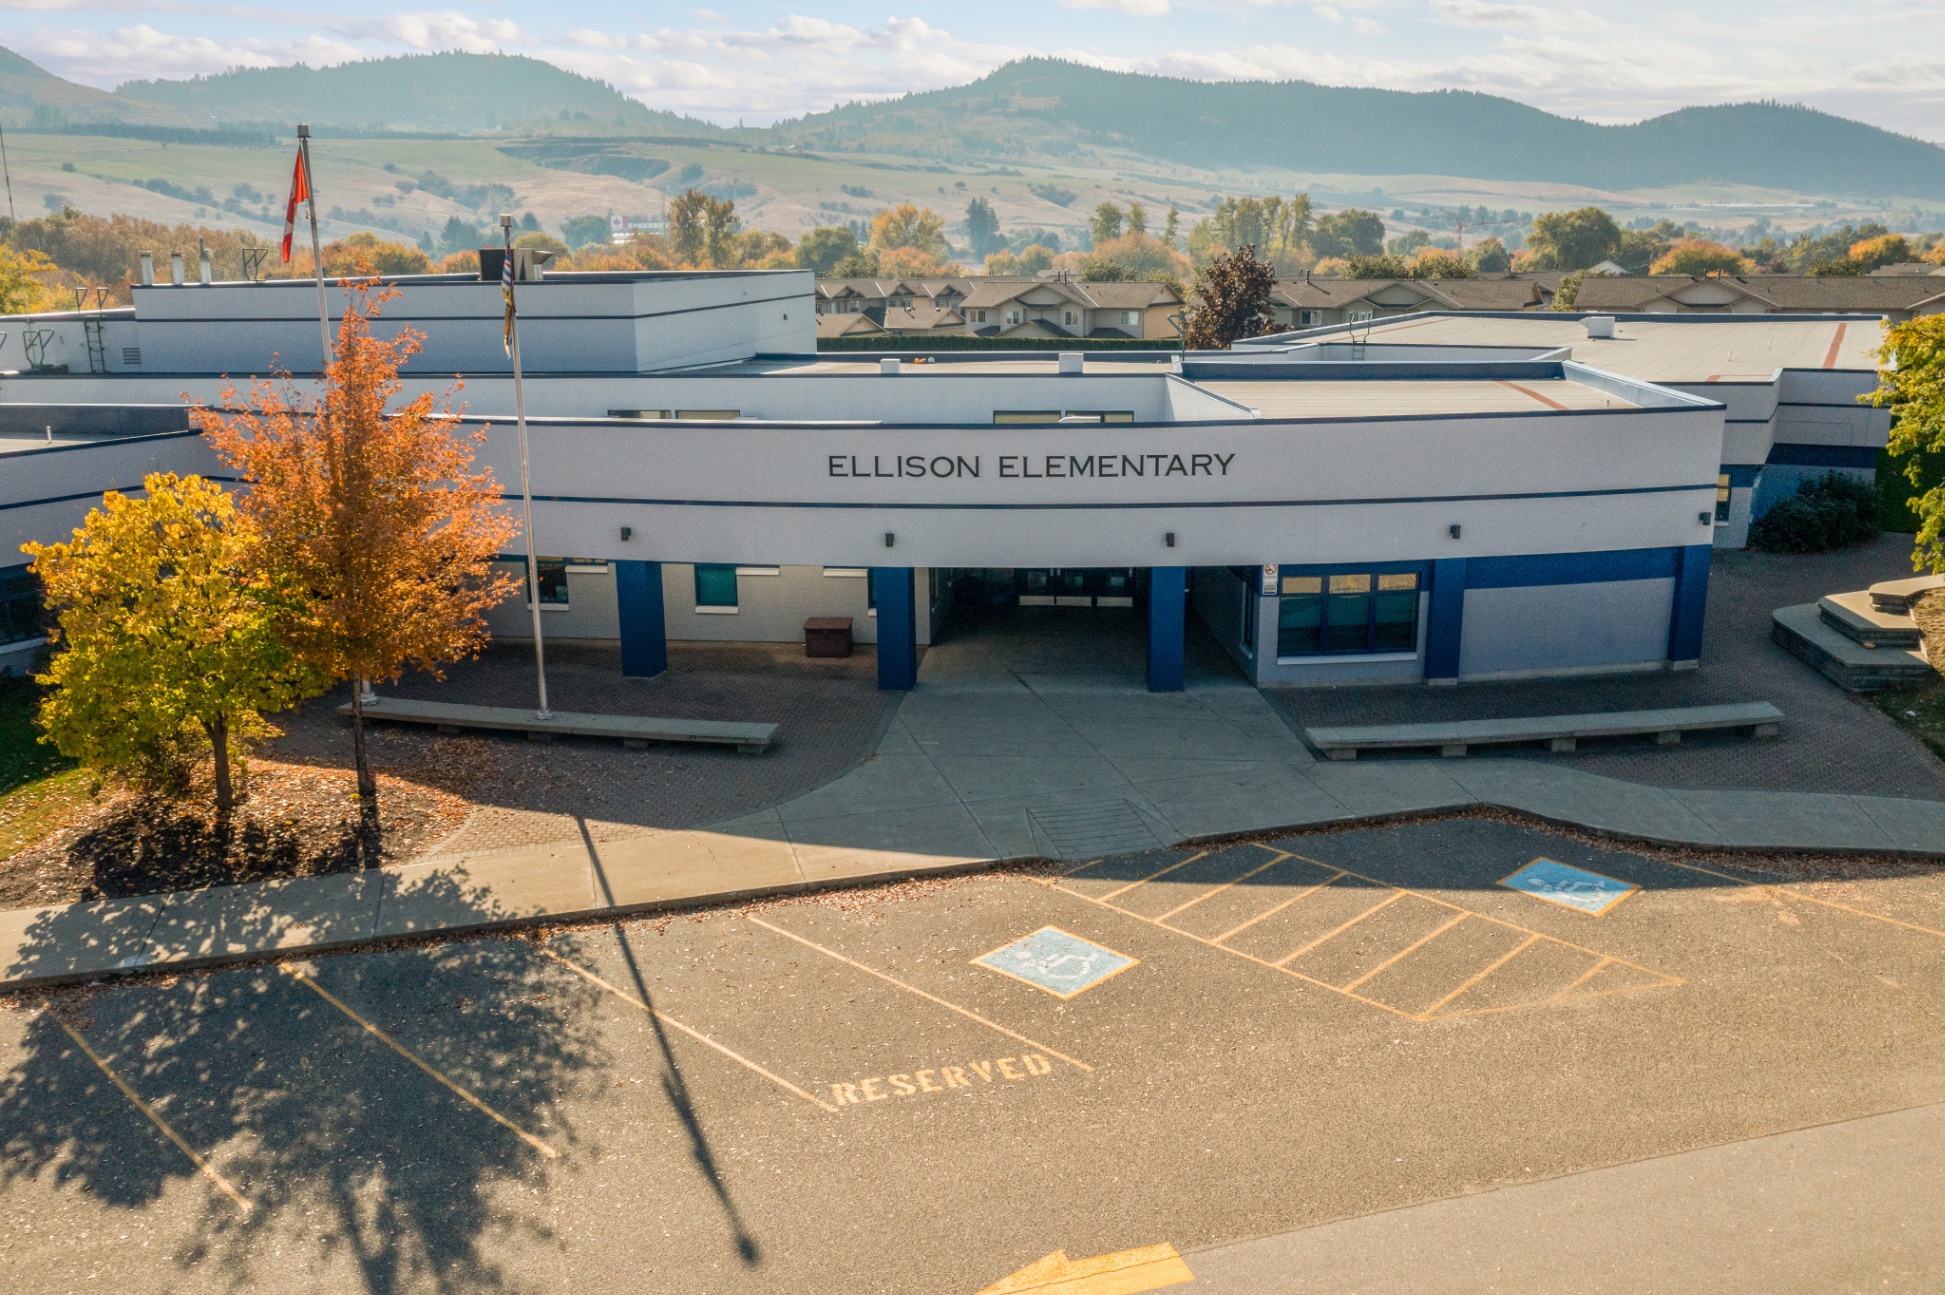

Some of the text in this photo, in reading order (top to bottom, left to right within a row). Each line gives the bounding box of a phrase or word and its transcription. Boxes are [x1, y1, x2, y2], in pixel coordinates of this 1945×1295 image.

[828, 453, 1236, 478] ELLISON ELEMENTARY
[831, 1053, 1052, 1106] RESERVED
